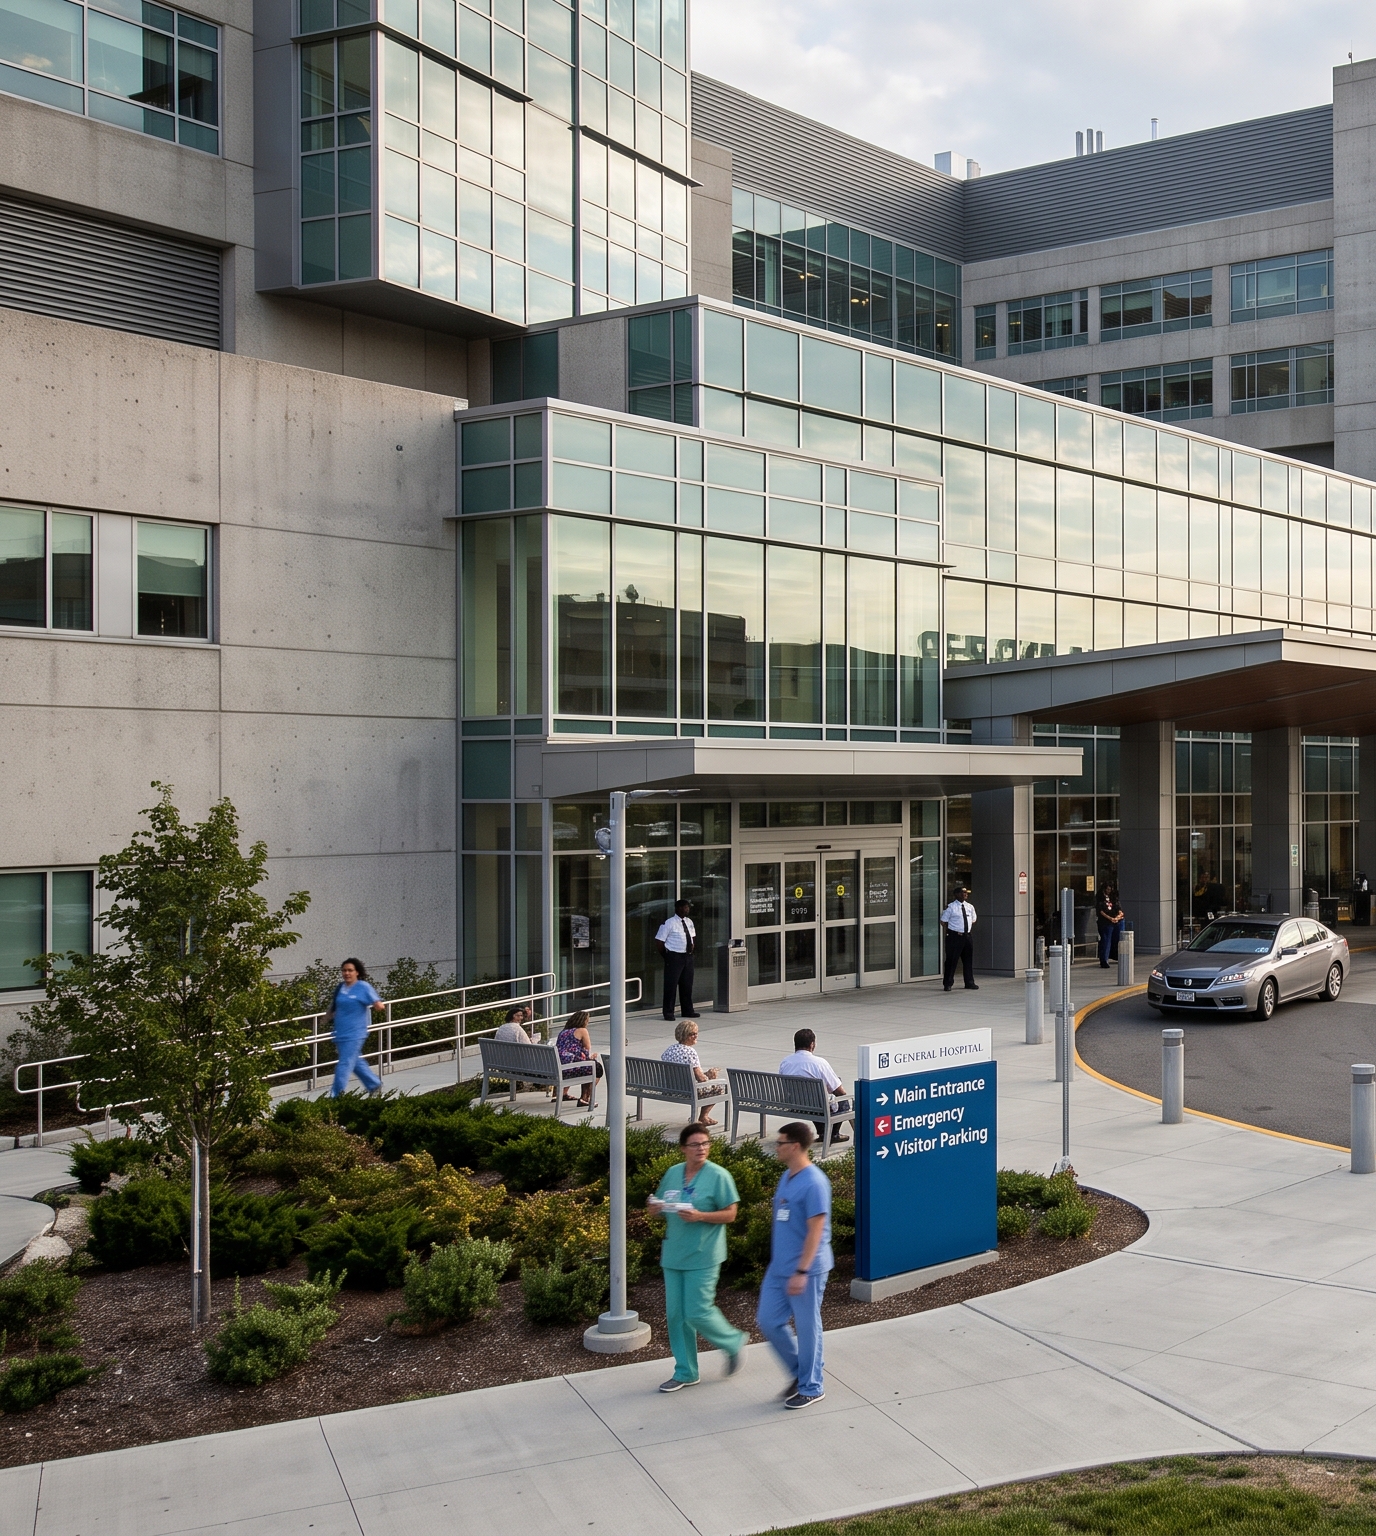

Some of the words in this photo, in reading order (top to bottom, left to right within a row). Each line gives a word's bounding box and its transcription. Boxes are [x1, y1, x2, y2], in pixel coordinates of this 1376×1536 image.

[894, 1050, 937, 1064] GENERAL
[939, 1043, 983, 1057] HOSPITAL
[894, 1086, 926, 1104] Main
[930, 1078, 985, 1098] Entrance
[894, 1107, 965, 1131] Emergency
[894, 1137, 937, 1157] Visitor
[940, 1126, 988, 1148] Parking
